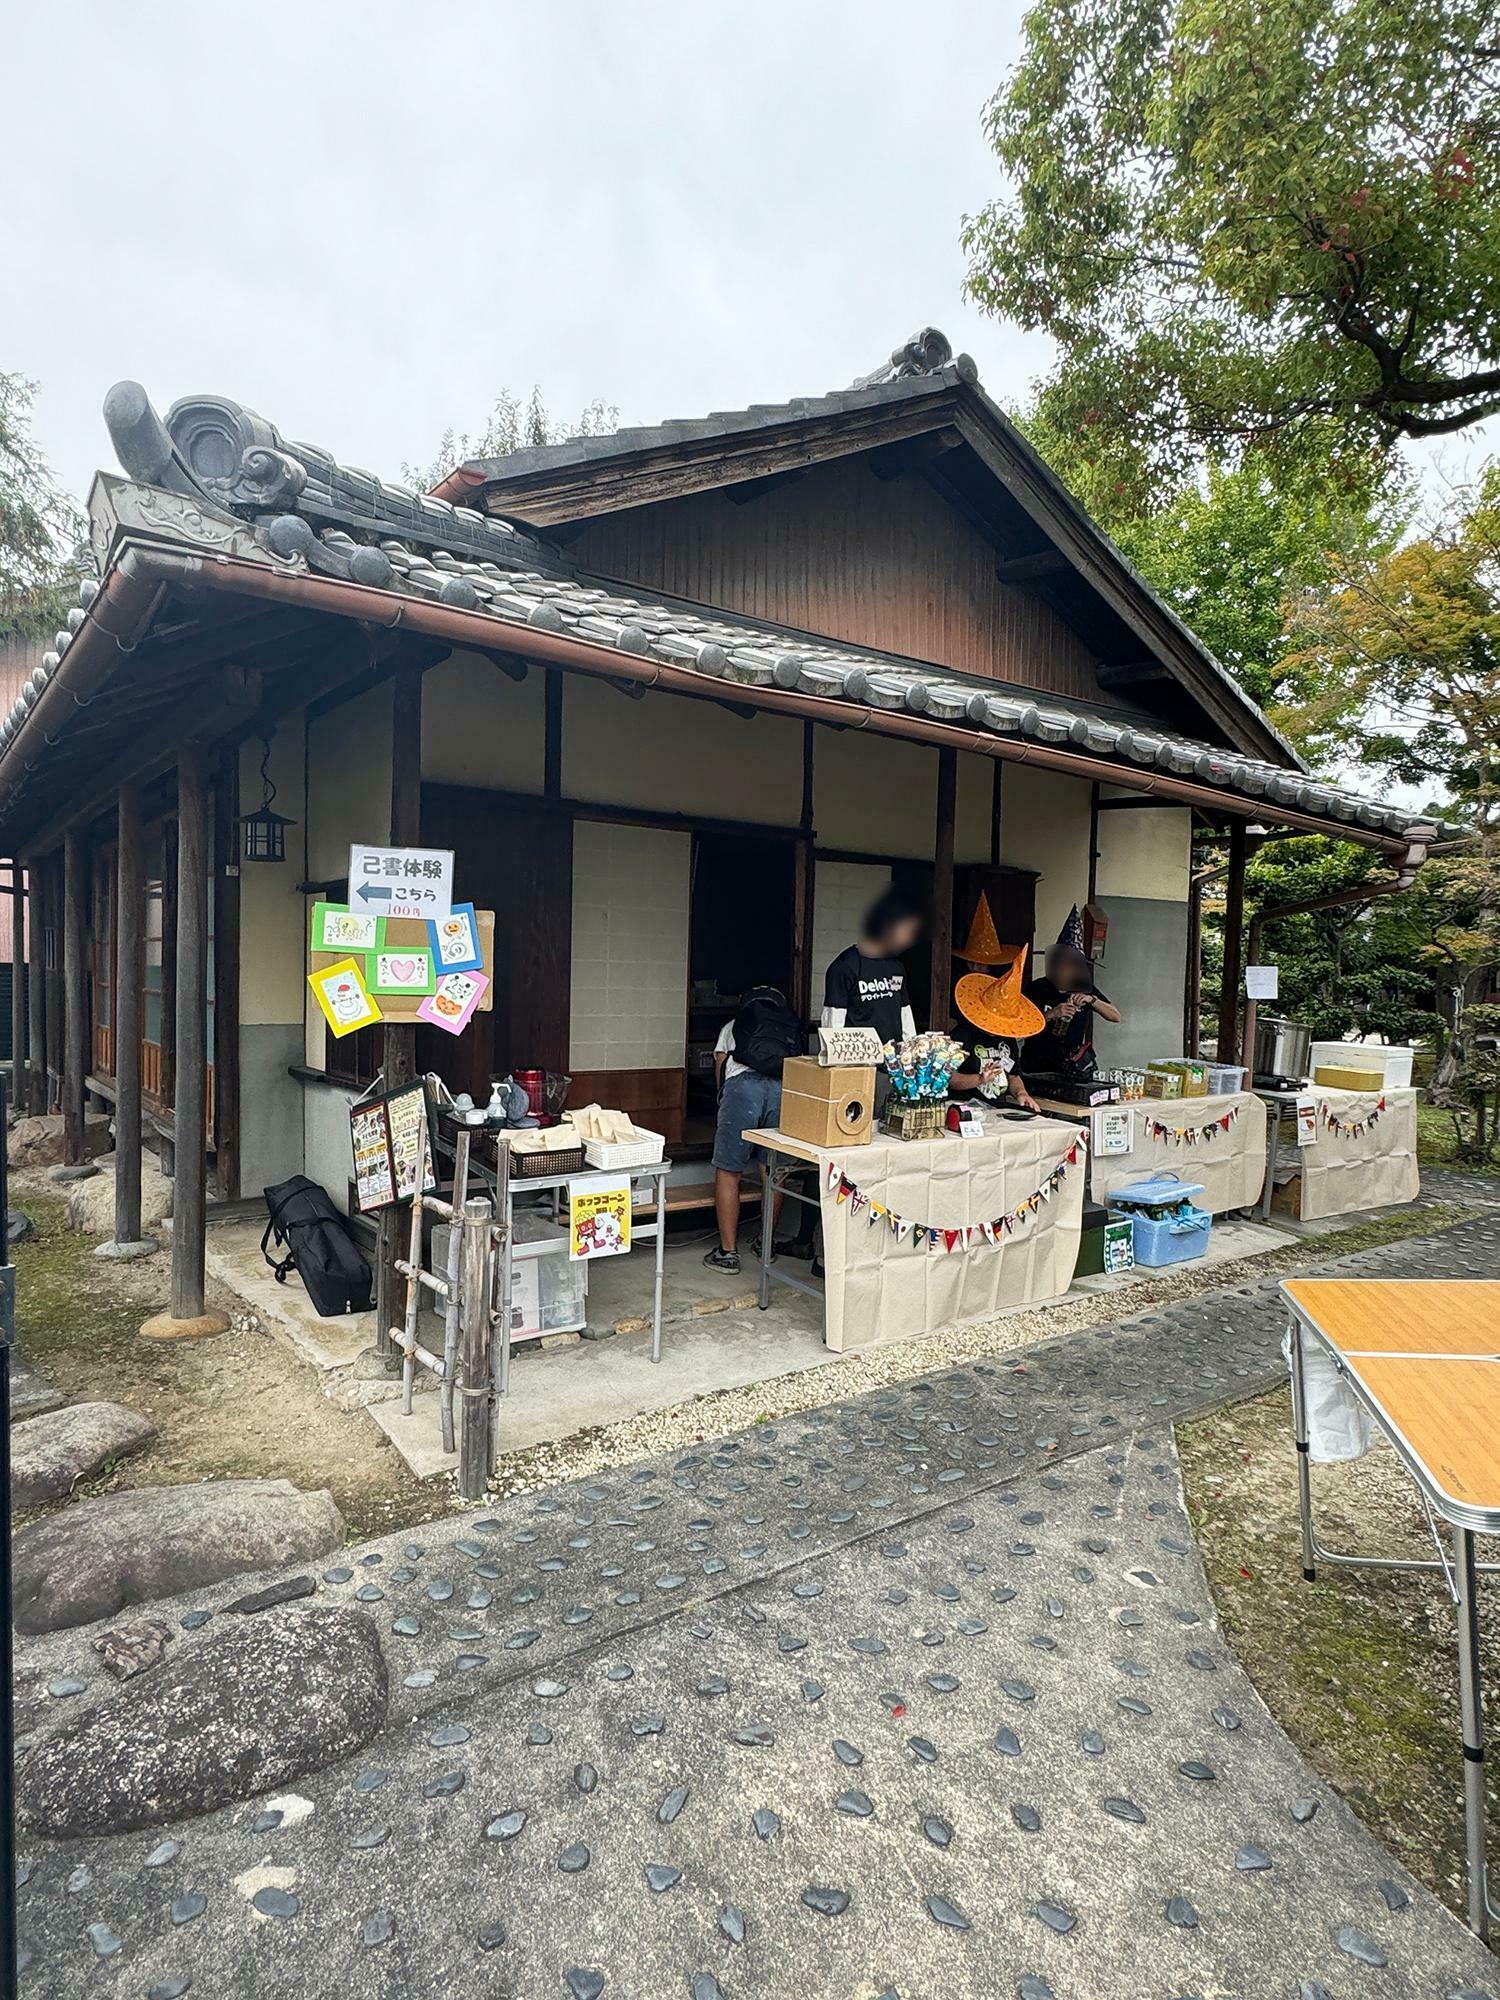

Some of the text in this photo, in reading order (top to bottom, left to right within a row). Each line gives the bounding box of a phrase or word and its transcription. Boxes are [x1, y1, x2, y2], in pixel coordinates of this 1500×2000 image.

[363, 855, 443, 879] 己書体験
[395, 887, 437, 902] こちら
[858, 977, 892, 993] Deloi
